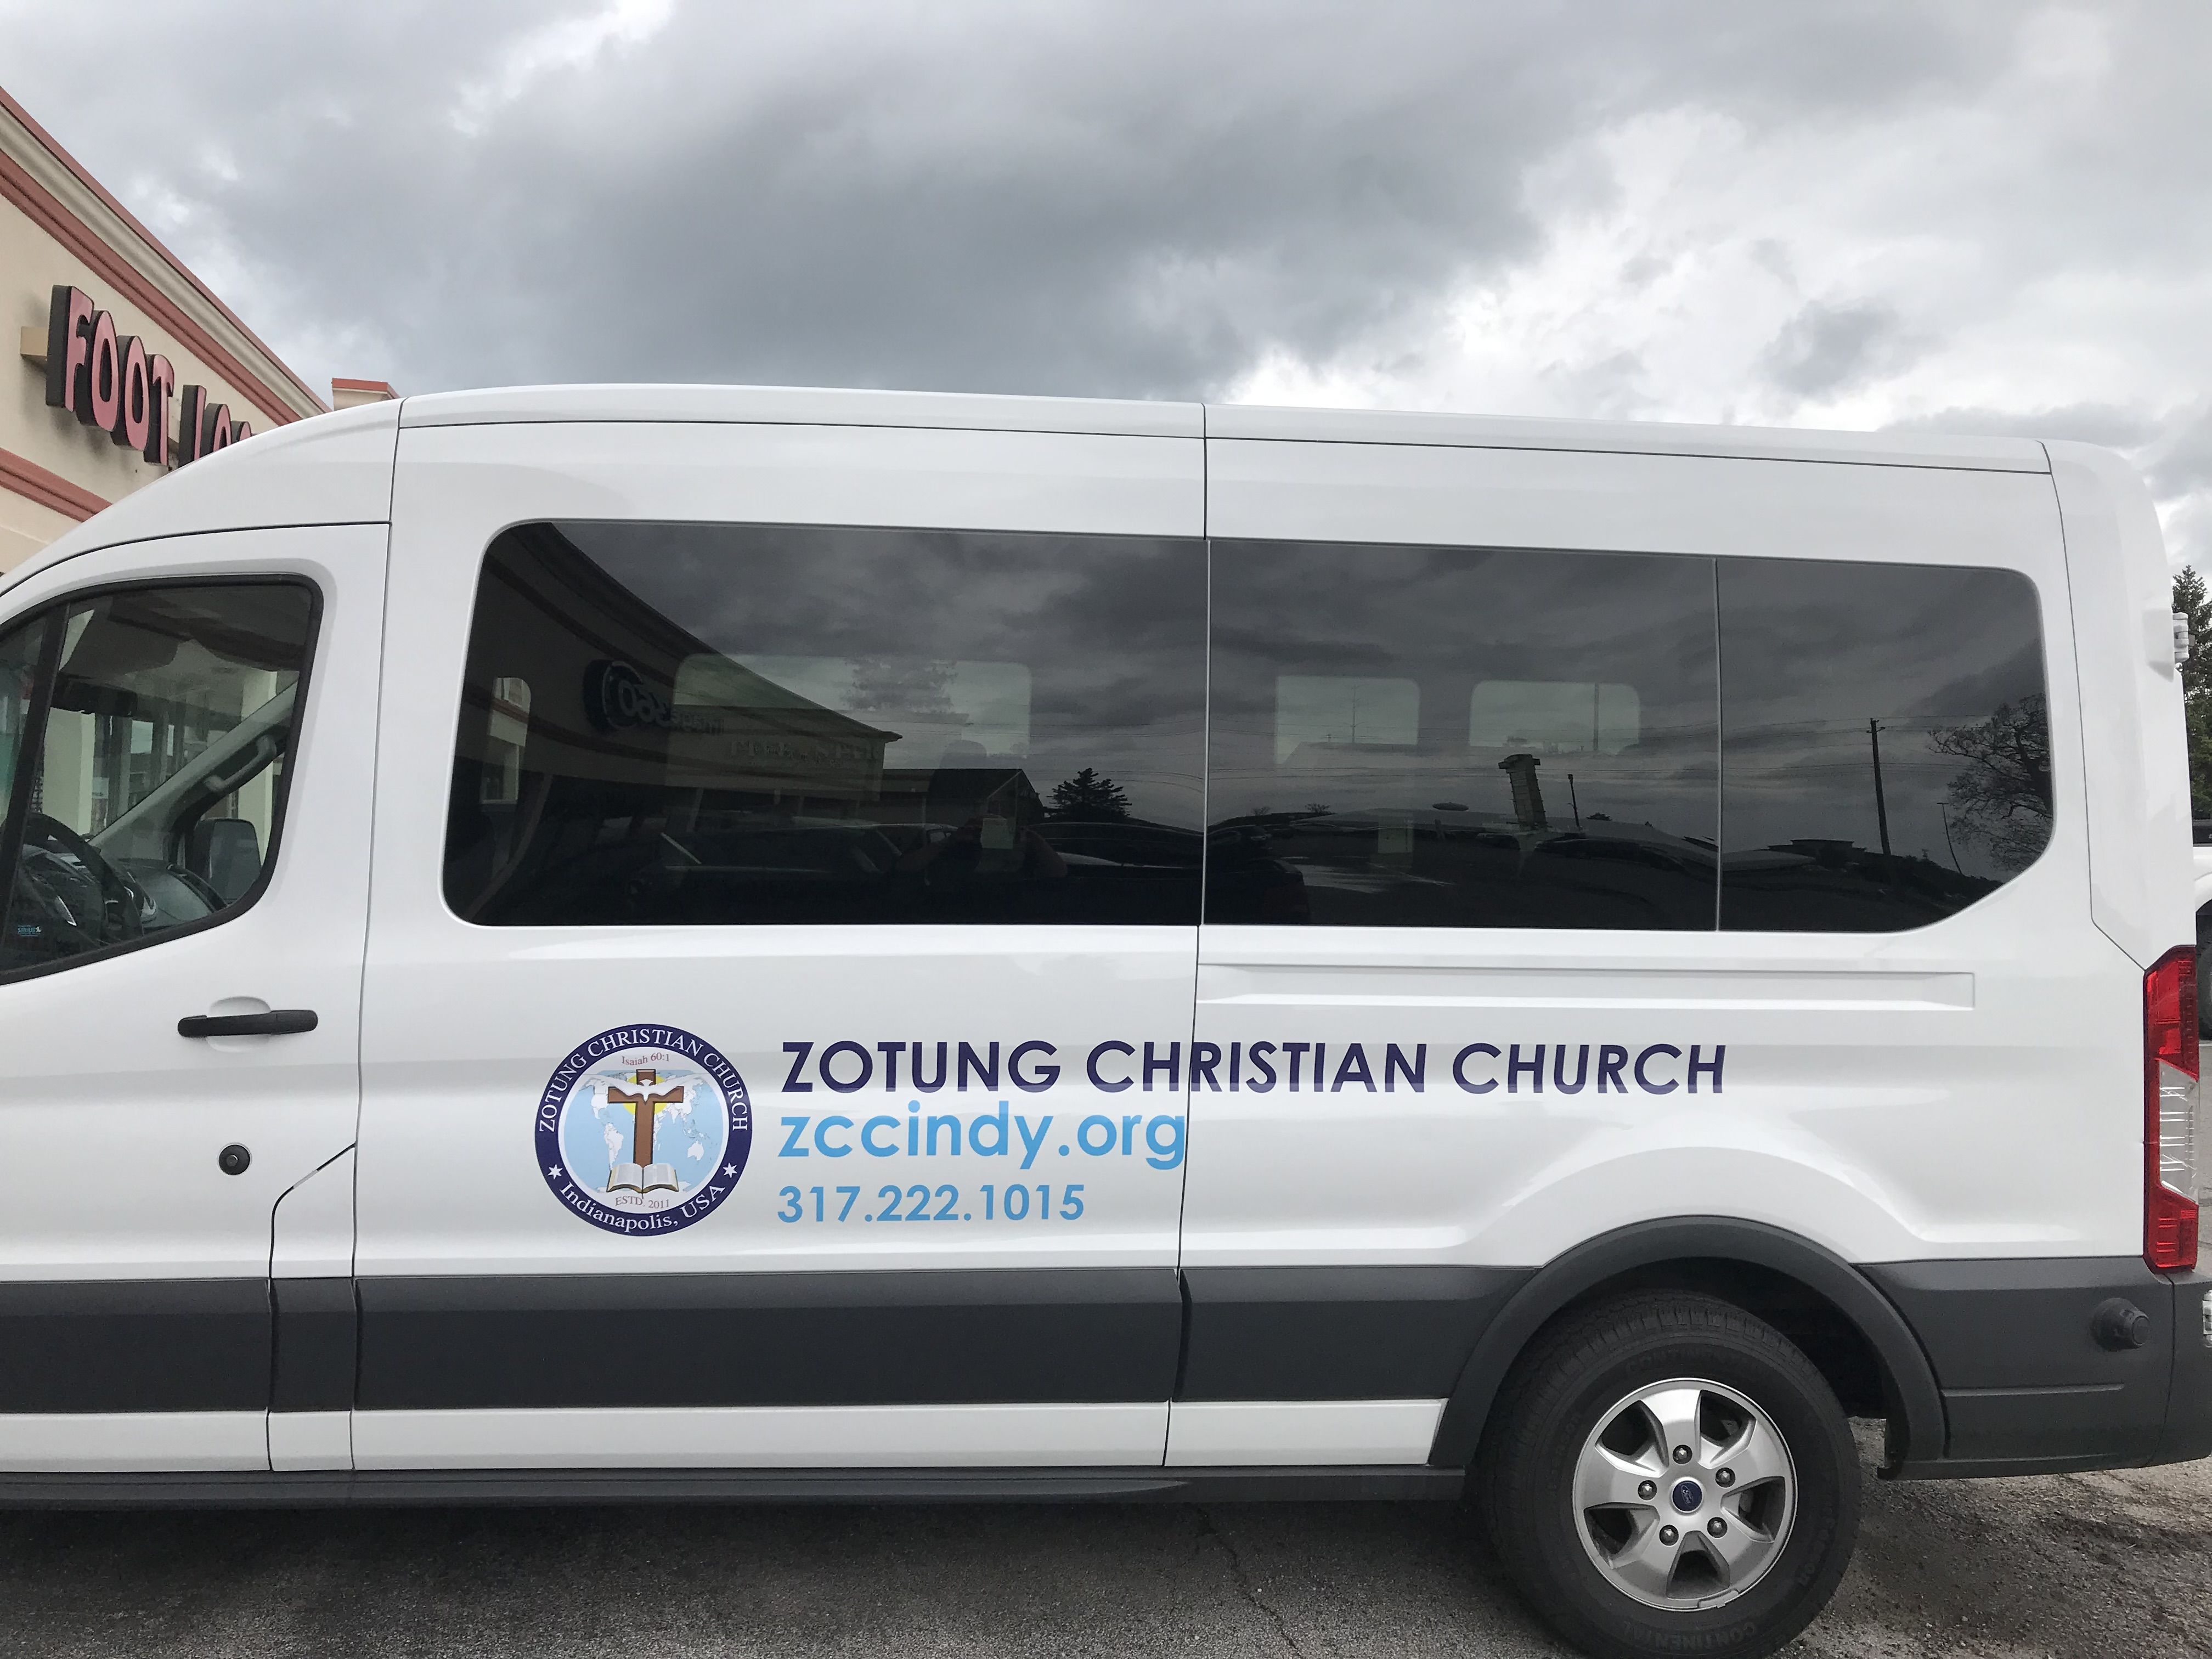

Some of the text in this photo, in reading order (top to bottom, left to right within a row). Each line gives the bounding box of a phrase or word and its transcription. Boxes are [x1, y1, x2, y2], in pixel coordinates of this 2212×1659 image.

[61, 285, 174, 465] FOOT
[539, 1028, 748, 1133] ZOTUNG CHRISTIAN CHURCH
[621, 1052, 670, 1066] Isaiah 60:1
[781, 1040, 1726, 1095] ZOTUNG CHRISTIAN CHURCH
[777, 1099, 1185, 1170] zccindy.org
[648, 1198, 670, 1209] 2011
[680, 1184, 726, 1218] USA
[777, 1184, 1085, 1223] 317.222.1015
